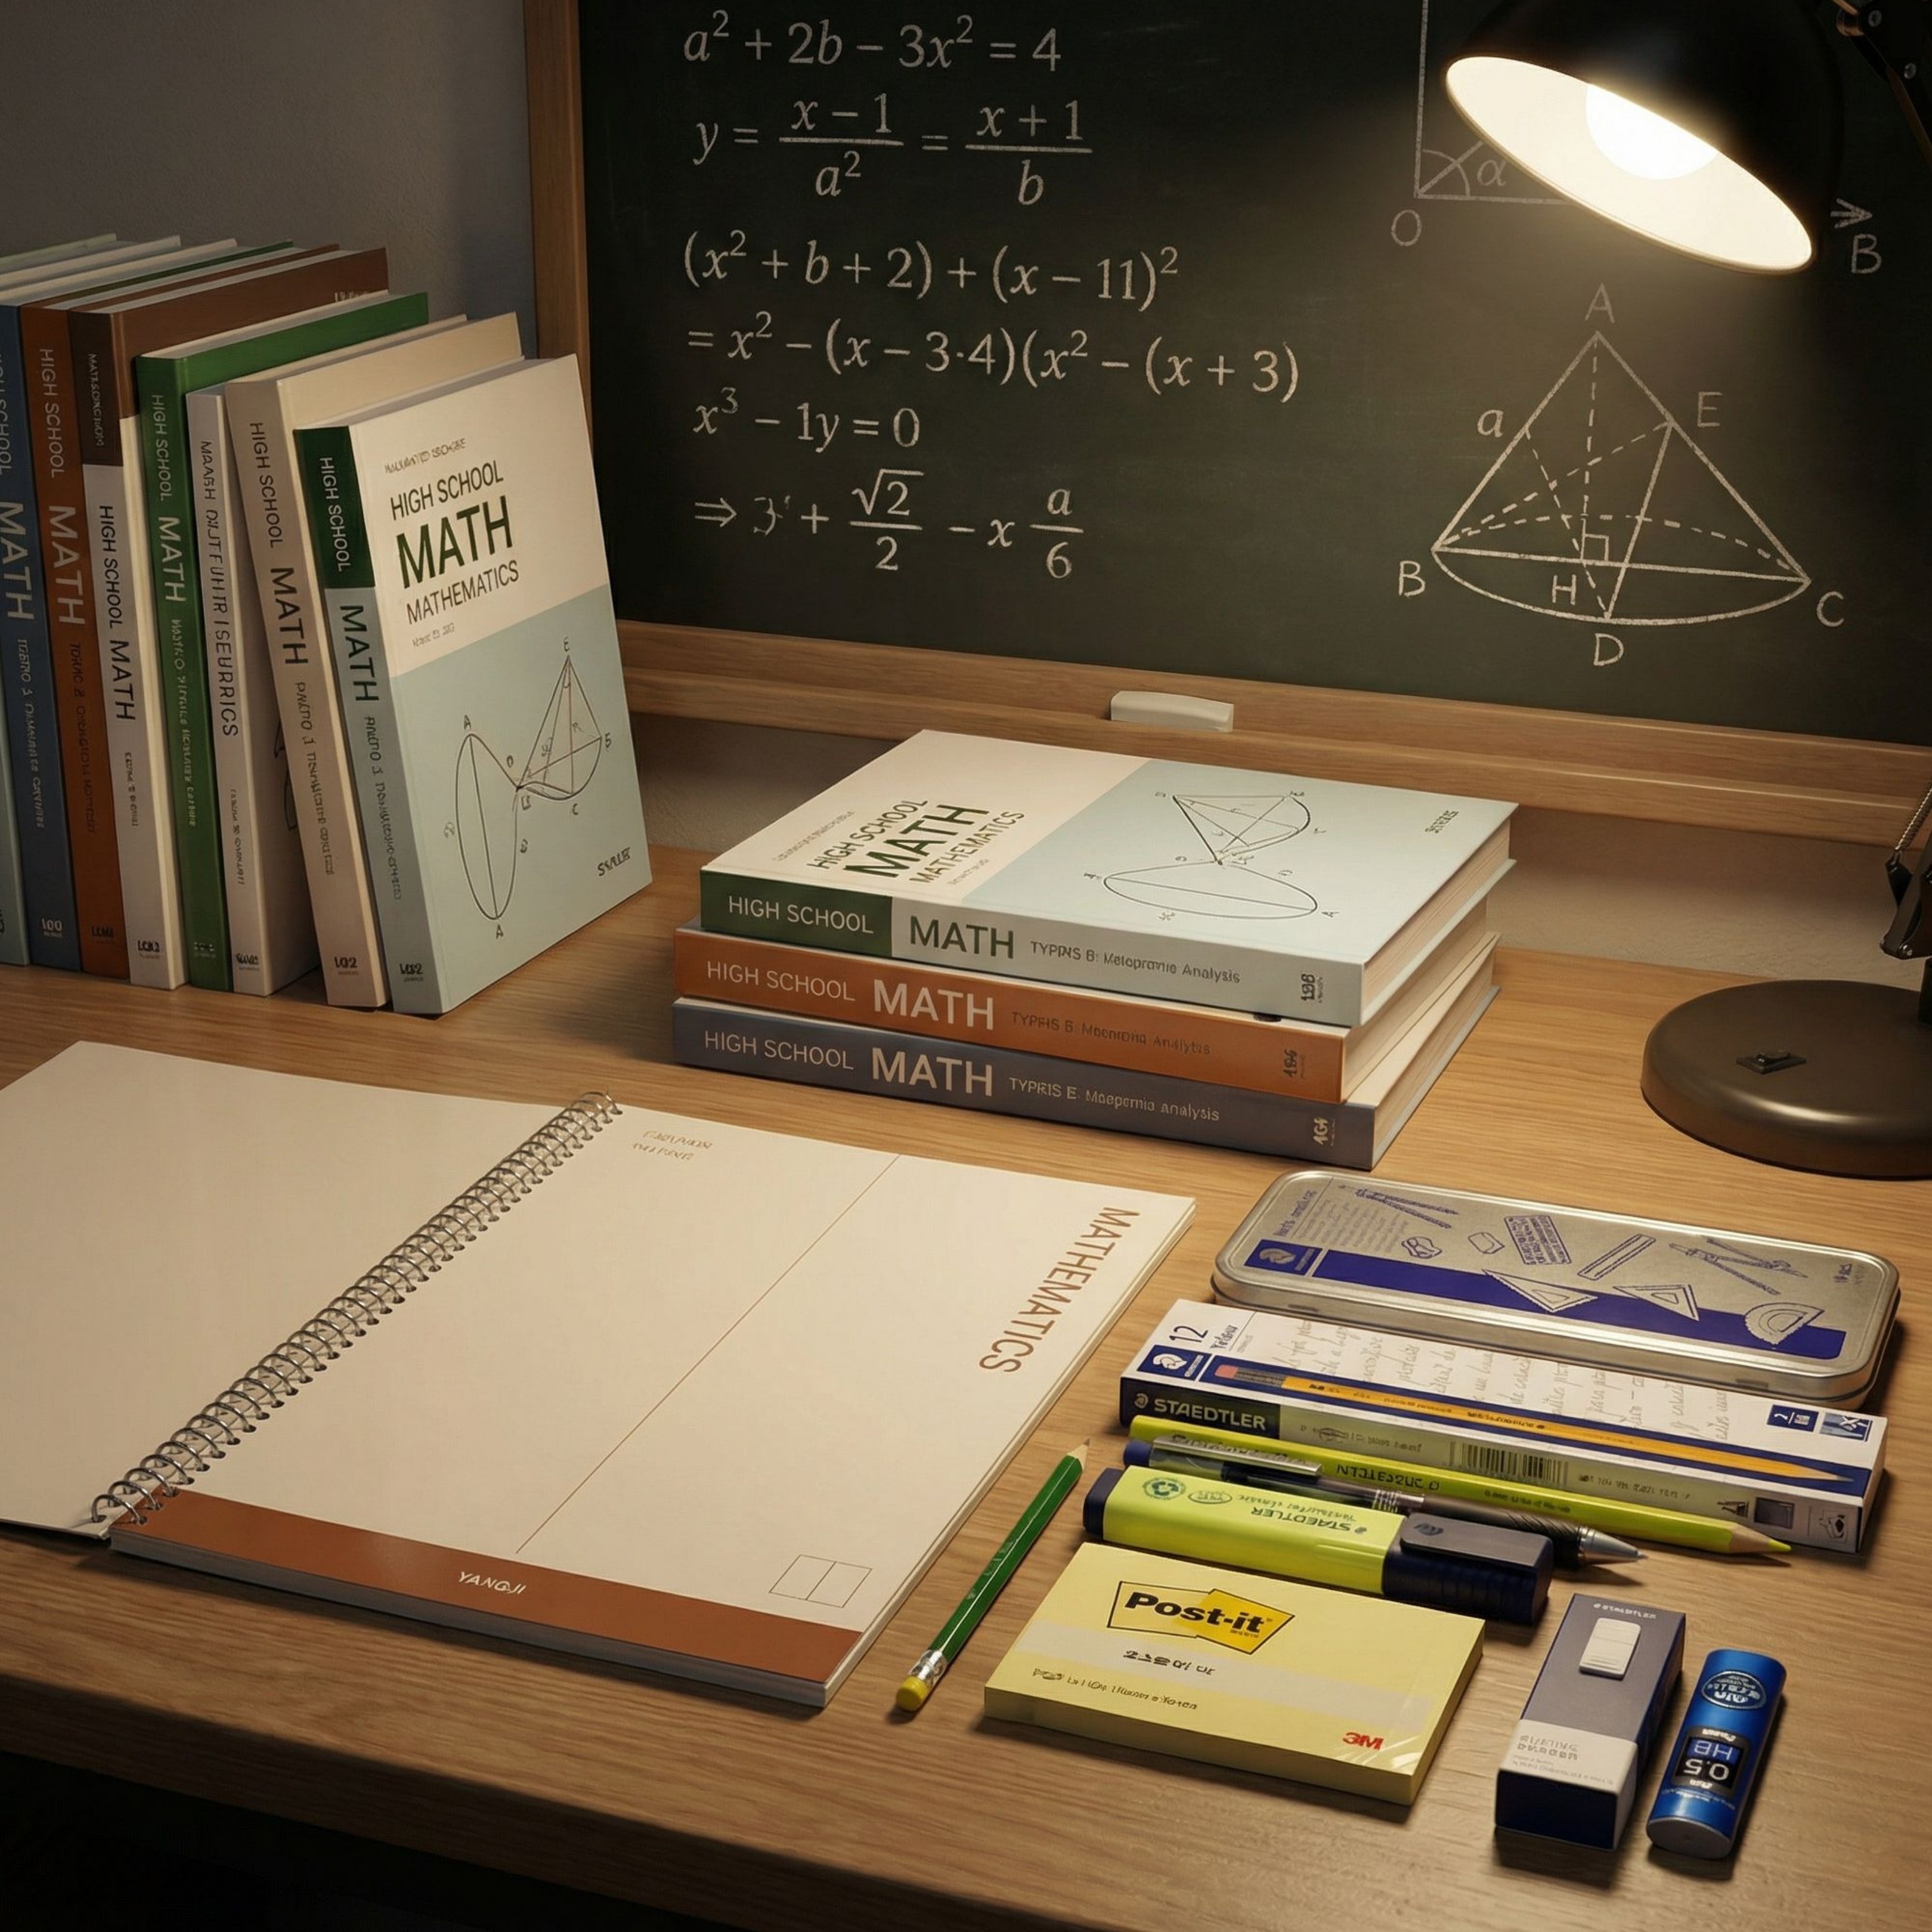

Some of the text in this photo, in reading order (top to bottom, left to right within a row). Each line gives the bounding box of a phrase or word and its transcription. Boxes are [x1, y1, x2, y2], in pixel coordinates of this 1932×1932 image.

[1852, 234, 1882, 274] B
[1586, 283, 1615, 323] A
[39, 349, 58, 397] HIGH
[45, 403, 64, 478] SCHOOL
[152, 395, 167, 435] HIGH
[1698, 392, 1722, 427] E
[156, 439, 172, 502] SCHOOL
[391, 460, 504, 521] HIGH SCHOOL
[0, 501, 35, 621] MATH
[49, 506, 85, 625] MATH
[159, 516, 186, 602] MATH
[250, 423, 308, 664] HIGH SCHOOL MATH
[396, 496, 513, 589] MATH
[320, 457, 379, 701] HIGH SCHOOL MATH
[406, 560, 519, 625] MATHEMATICS
[1399, 561, 1425, 596] B
[1552, 574, 1577, 605] H
[1817, 592, 1844, 627] C
[100, 505, 136, 720] HIGH SCHOOL MATH
[1594, 633, 1624, 666] D
[807, 841, 856, 869] HIGH
[850, 799, 928, 842] SCHOOL
[843, 804, 990, 878] MATH
[909, 811, 1025, 884] MATHEMATICS
[729, 896, 779, 920] HIGH
[787, 904, 874, 934] SCHOOL
[909, 915, 1014, 959] MATH
[707, 961, 759, 986] HIGH
[766, 970, 856, 1001] SCHOOL
[874, 979, 994, 1030] MATH
[705, 1030, 757, 1055] HIGH
[764, 1041, 854, 1070] SCHOOL
[872, 1047, 993, 1097] MATH
[979, 1207, 1140, 1372] MATHEMATICS
[1169, 1325, 1209, 1343] 12
[1154, 1398, 1266, 1431] STAEDTLER
[1252, 1507, 1351, 1532] STAEDTLER
[1125, 1592, 1265, 1634] Post-it
[1343, 1732, 1384, 1751] 3M
[1683, 1759, 1729, 1780] 0.5
[1694, 1740, 1733, 1760] HB
